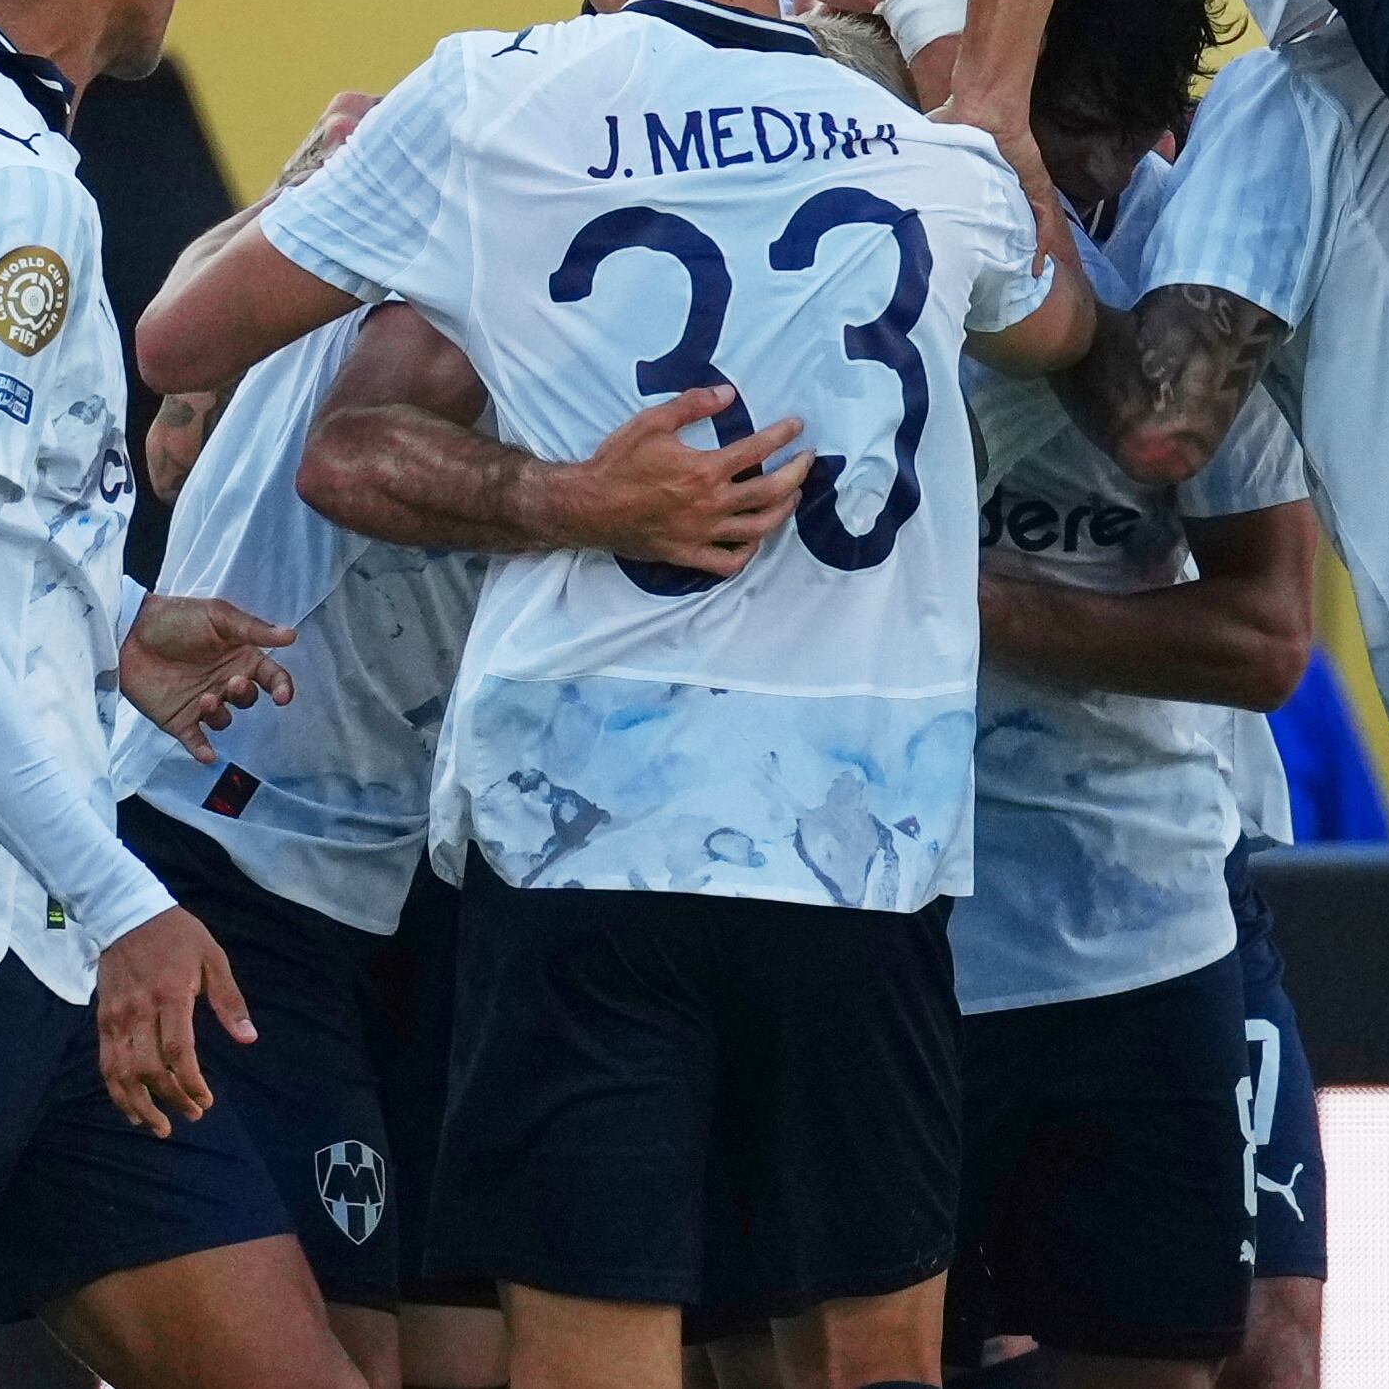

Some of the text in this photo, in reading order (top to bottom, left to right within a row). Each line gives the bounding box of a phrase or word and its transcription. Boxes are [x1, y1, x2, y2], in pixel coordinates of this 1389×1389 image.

[587, 115, 633, 179] J.
[47, 263, 64, 287] CUP
[8, 324, 38, 348] FIFA
[548, 186, 934, 597] 33
